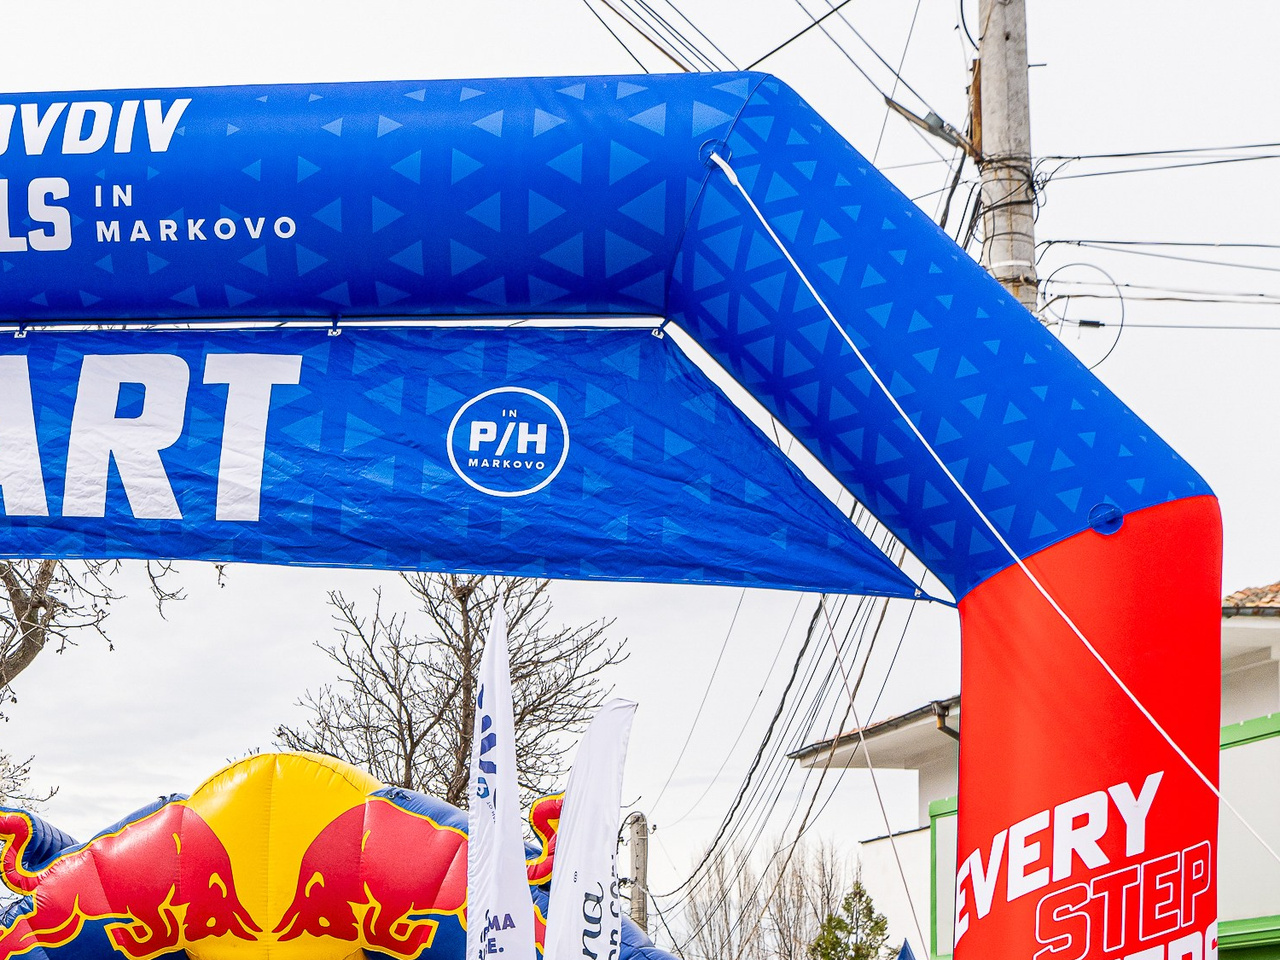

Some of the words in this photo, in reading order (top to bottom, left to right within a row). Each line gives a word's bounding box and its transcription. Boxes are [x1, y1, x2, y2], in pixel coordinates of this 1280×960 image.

[94, 185, 133, 207] IN
[95, 216, 297, 243] MARKOVO
[501, 409, 518, 418] IN
[469, 421, 547, 456] P/H
[468, 458, 545, 470] MARKOVO
[954, 771, 1164, 948] EVERY
